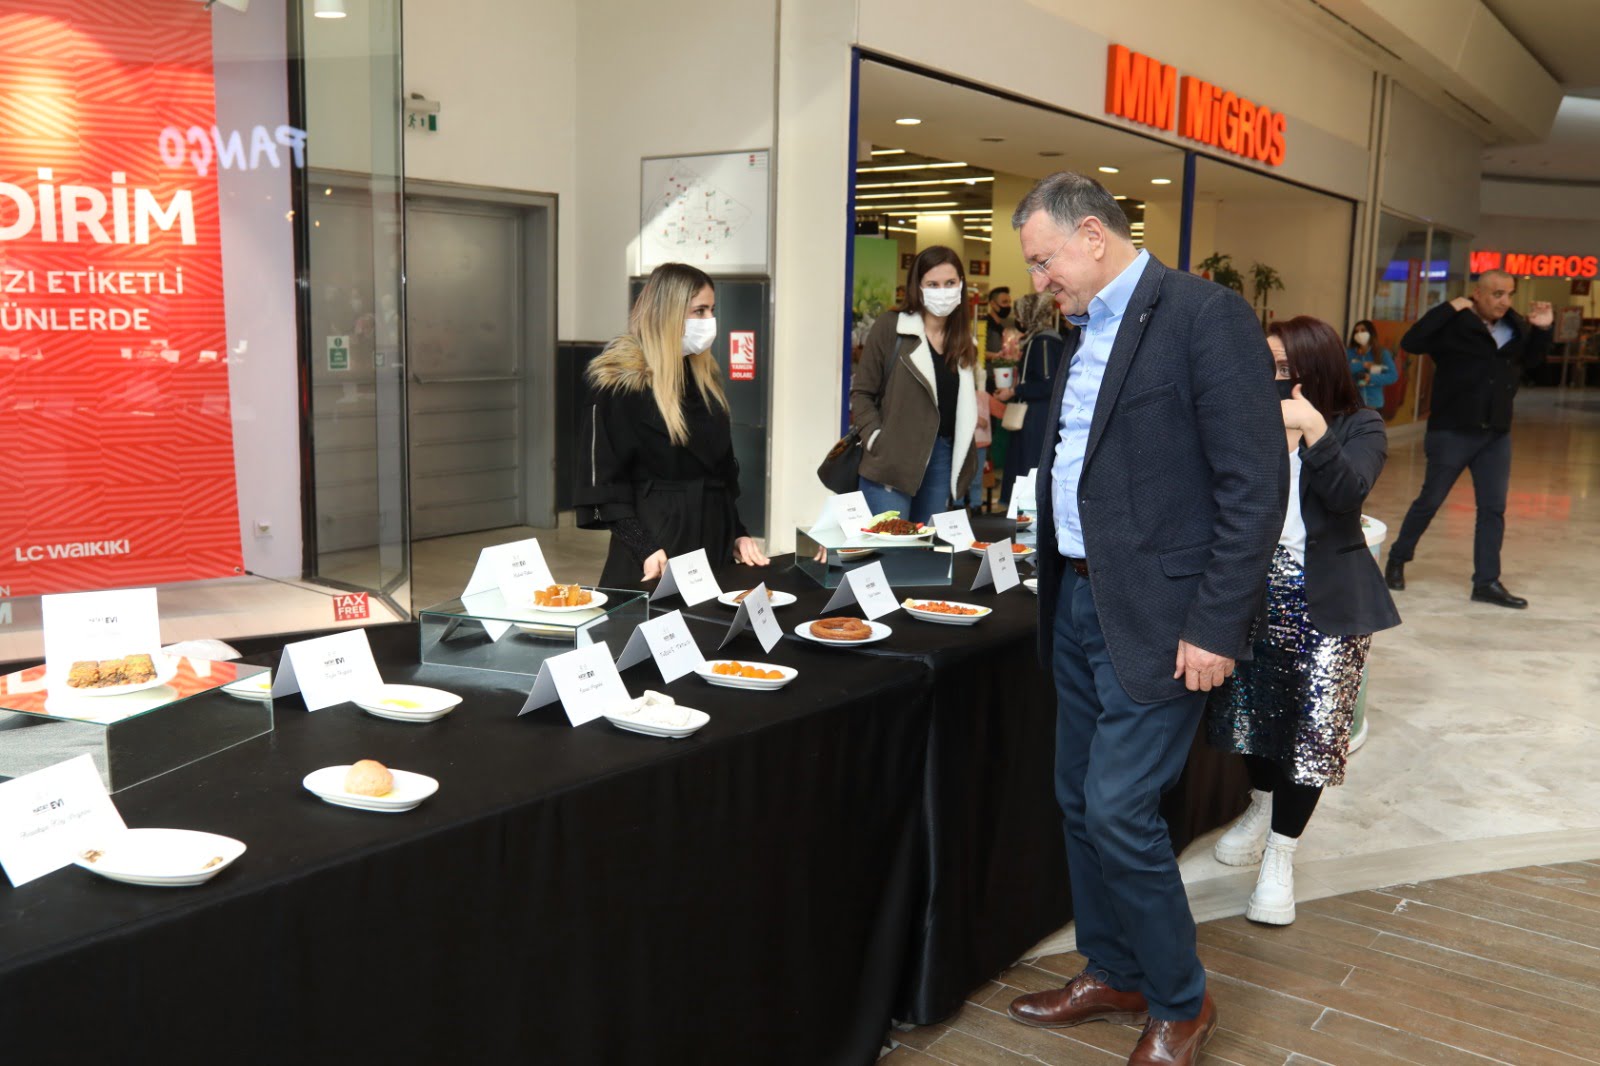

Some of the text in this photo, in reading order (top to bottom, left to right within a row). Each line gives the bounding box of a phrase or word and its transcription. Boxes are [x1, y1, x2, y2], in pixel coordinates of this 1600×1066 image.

[1105, 43, 1177, 132] MM
[0, 266, 184, 294] ZI ETİKETLİ
[1, 302, 151, 331] ÜNLERDE
[15, 545, 44, 562] LC
[334, 592, 365, 607] TAX
[338, 605, 366, 615] FREE
